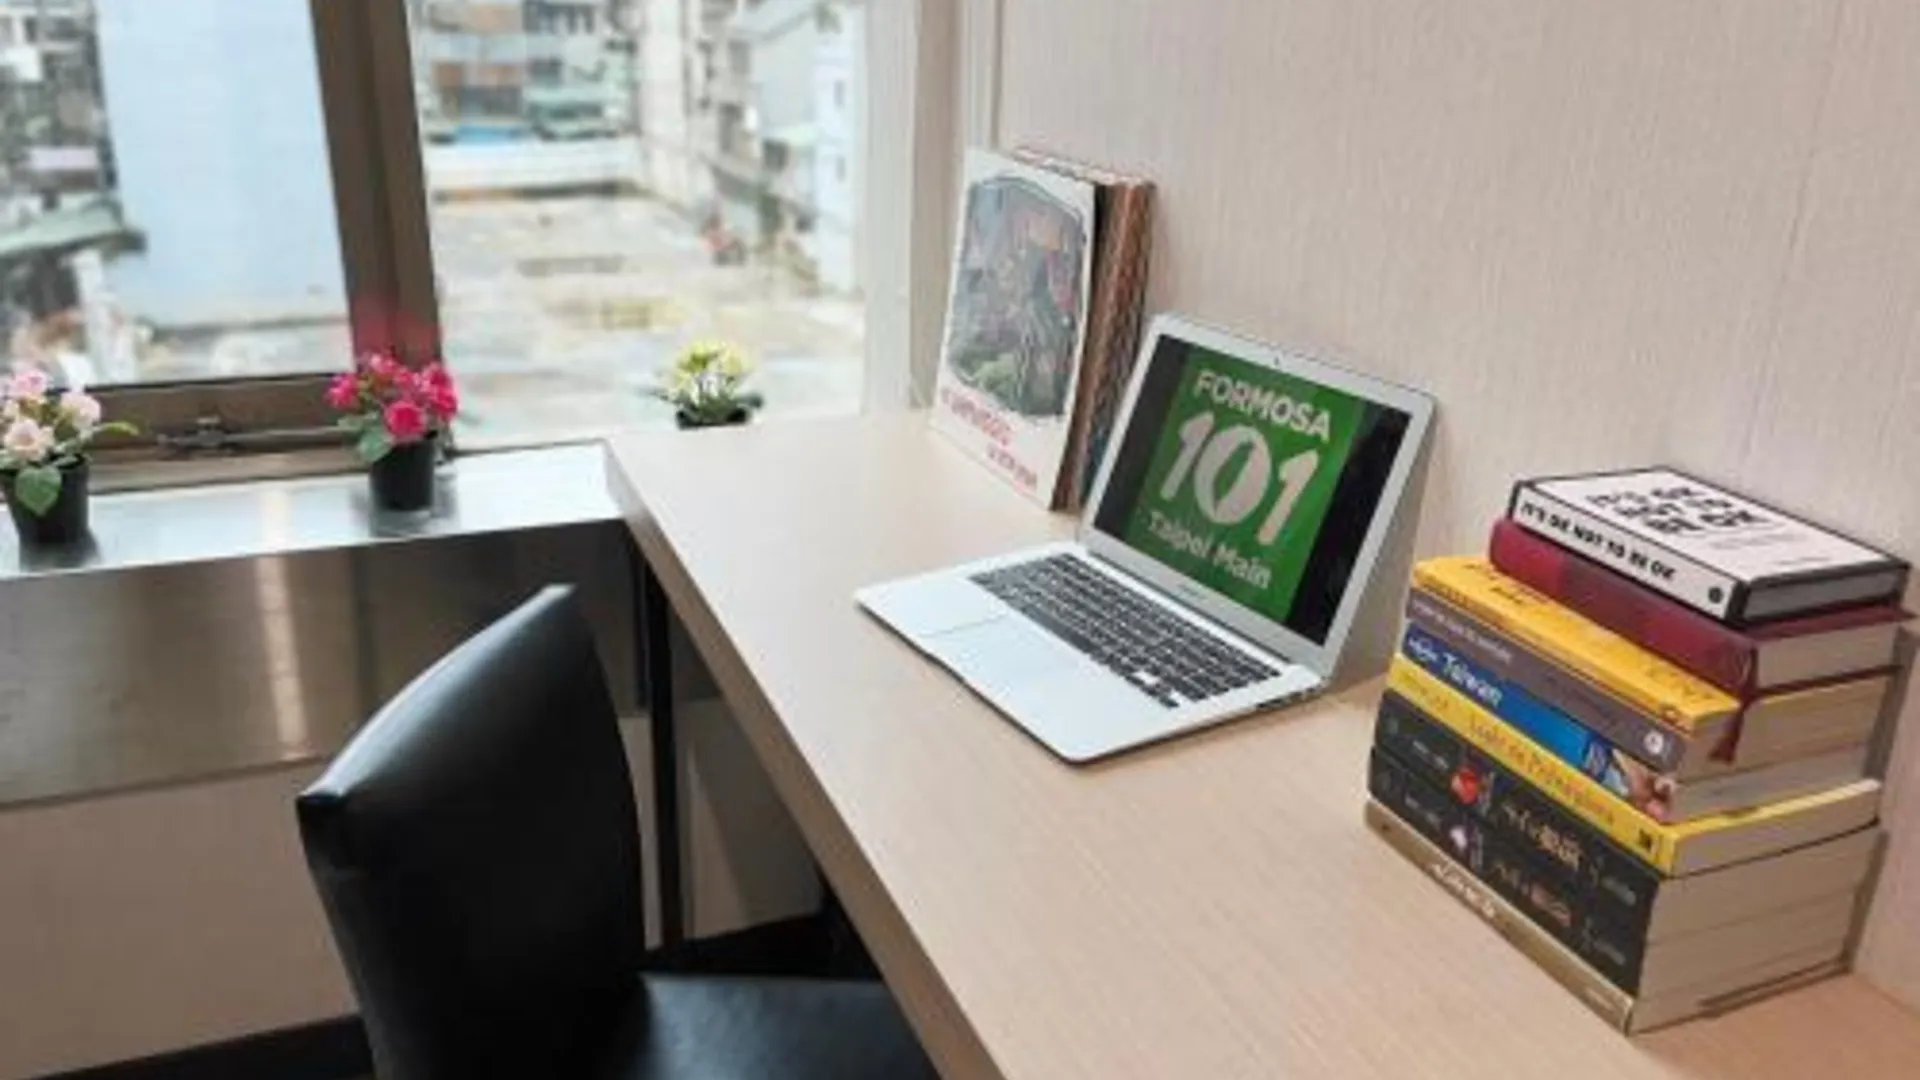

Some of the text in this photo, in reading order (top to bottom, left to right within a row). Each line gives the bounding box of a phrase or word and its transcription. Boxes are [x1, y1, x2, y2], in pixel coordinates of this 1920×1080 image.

[1193, 370, 1330, 442] FORMOSA
[1159, 411, 1319, 546] 101
[1149, 511, 1271, 589] Taipei Main
[1573, 522, 1602, 545] NOT
[1606, 538, 1625, 558] TO
[1650, 559, 1676, 581] OK
[1441, 652, 1502, 707] Taiwan
